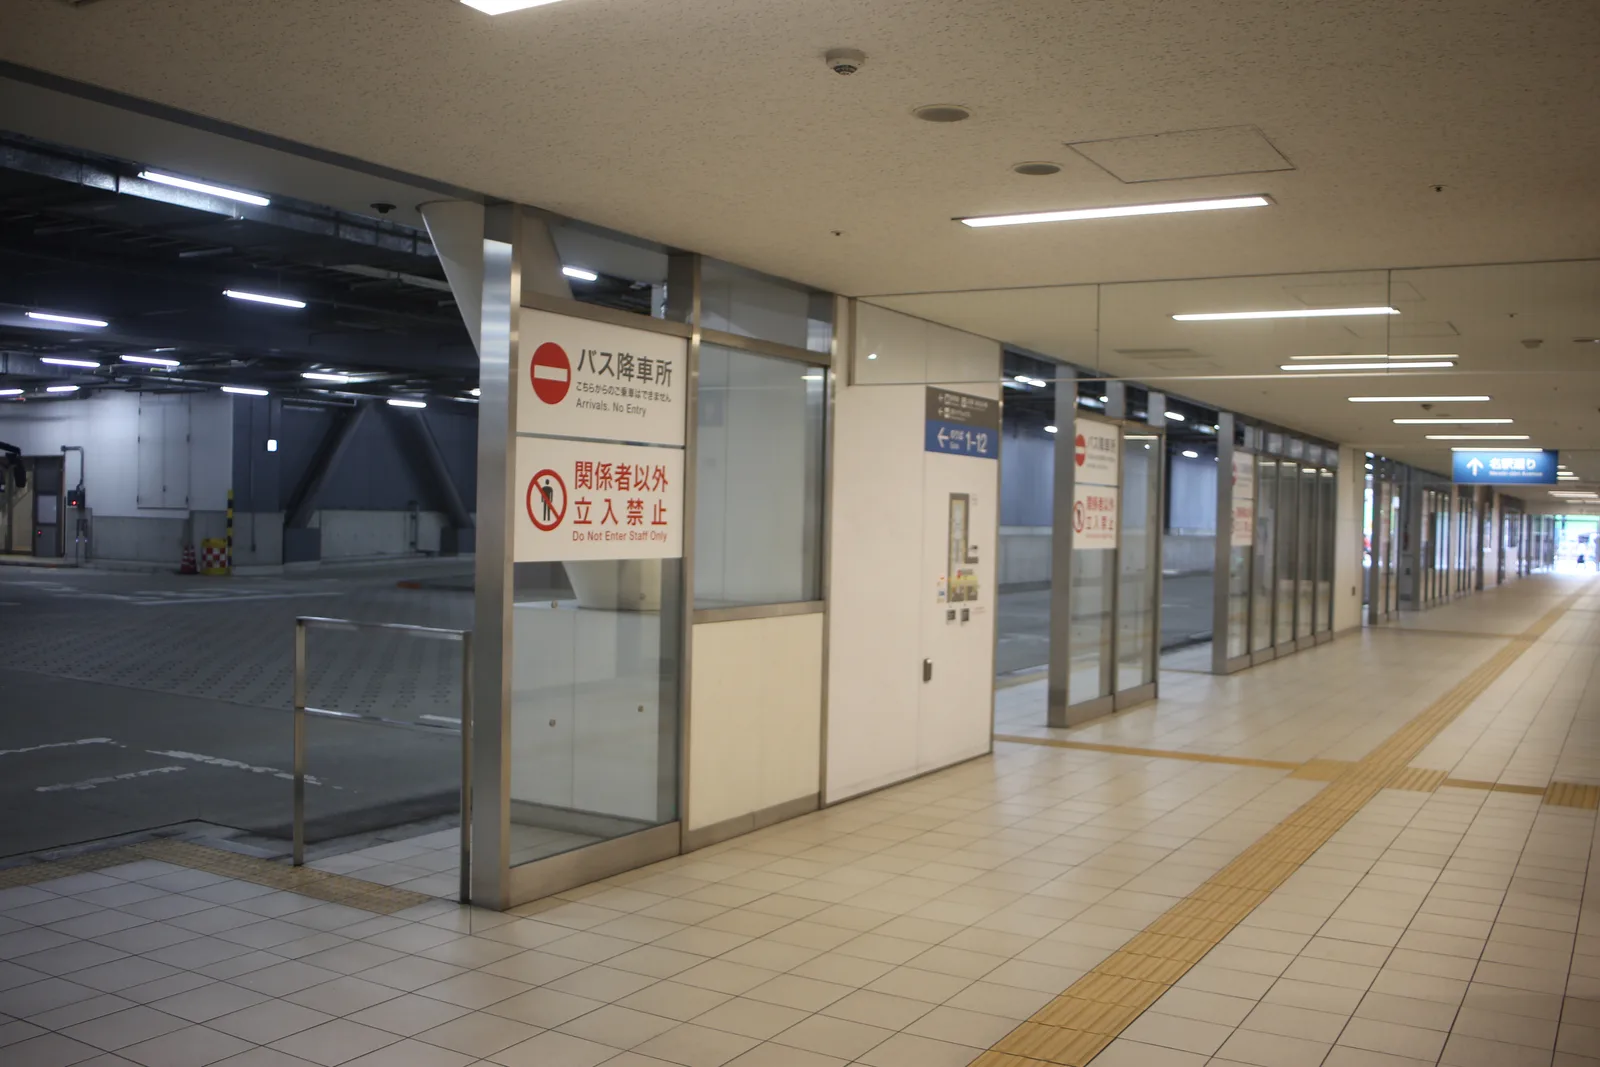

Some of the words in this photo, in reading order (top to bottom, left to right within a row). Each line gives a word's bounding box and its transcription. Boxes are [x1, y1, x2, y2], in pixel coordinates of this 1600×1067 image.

[577, 349, 672, 387] バス降車所
[613, 402, 624, 413] No
[627, 403, 647, 417] Entry
[574, 461, 668, 492] 関係者以外
[573, 496, 667, 526] 立入禁止
[572, 530, 584, 541] Do
[587, 530, 602, 541] Not
[605, 530, 627, 541] Enter
[629, 530, 648, 541] Staff
[650, 530, 667, 543] Only
